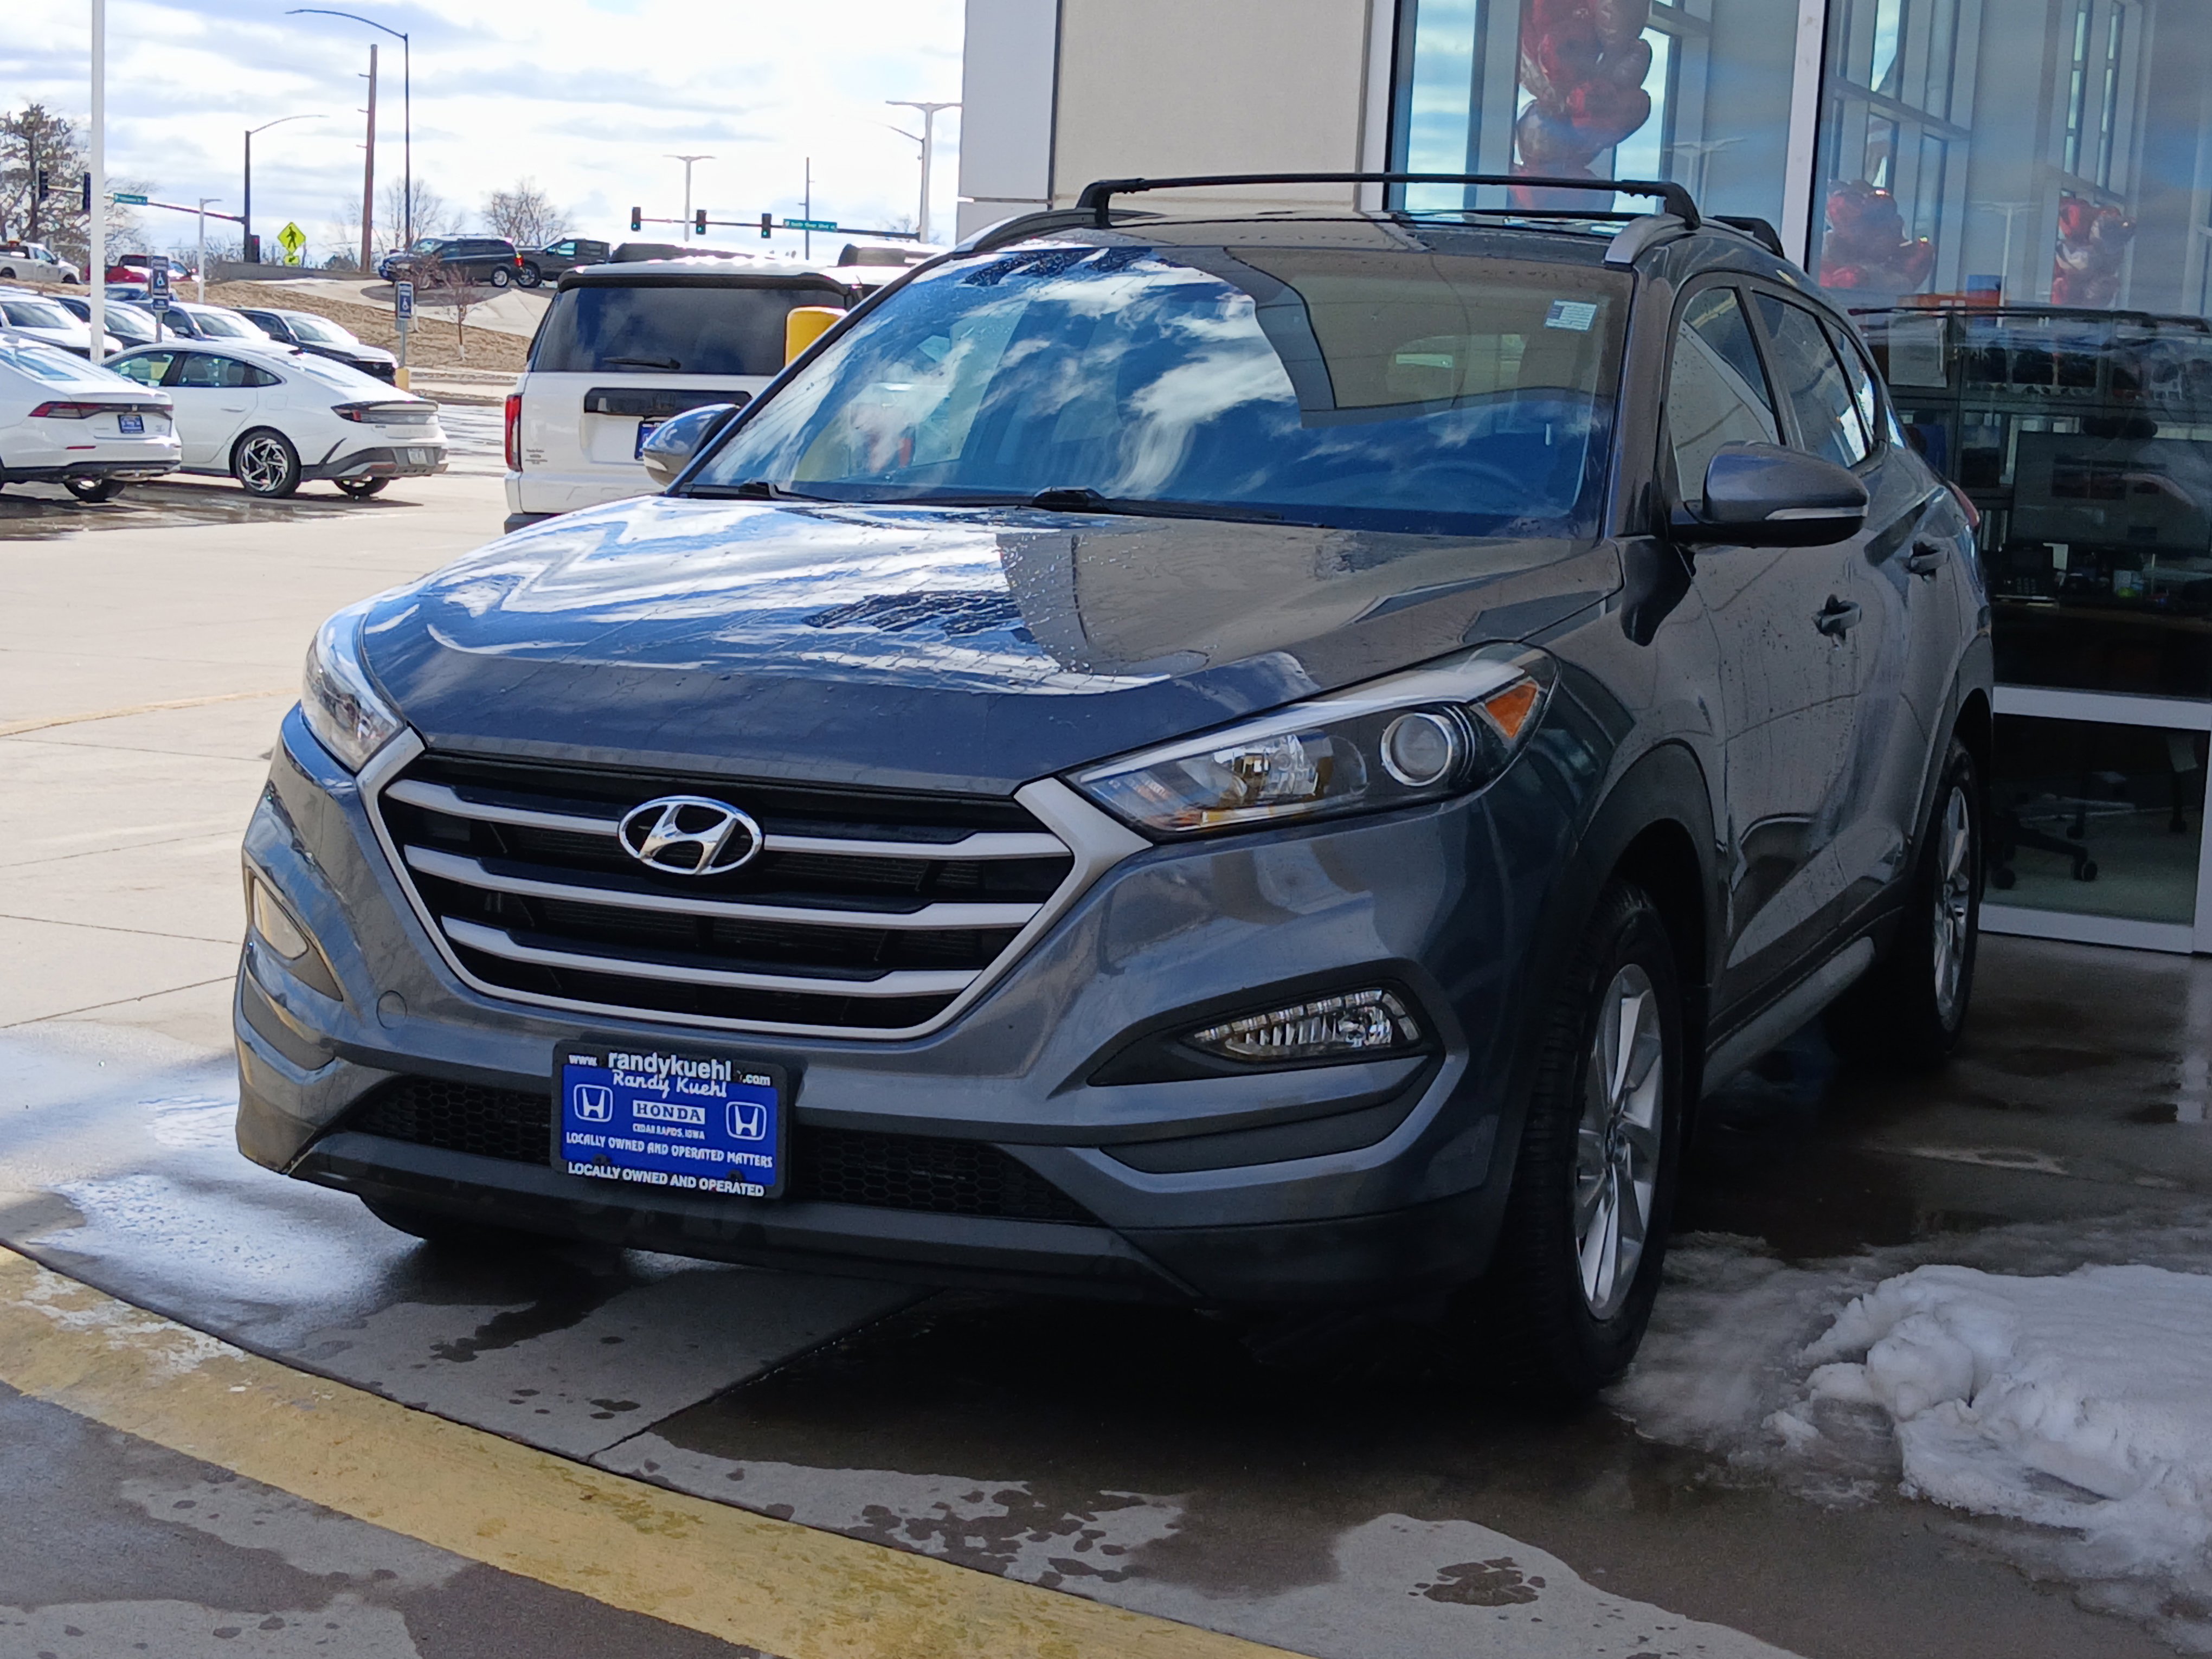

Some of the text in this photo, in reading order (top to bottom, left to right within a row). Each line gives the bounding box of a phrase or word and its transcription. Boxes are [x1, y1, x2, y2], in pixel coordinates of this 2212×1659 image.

[608, 1052, 731, 1082] randykuehl
[742, 1073, 771, 1086] .com
[612, 1069, 727, 1099] Randy Kuehl
[636, 1103, 702, 1122] HONDA
[566, 1131, 773, 1168] LOCALLY OWNED AND OPERATED MATTERS
[568, 1161, 764, 1197] LOCALLY OWNED AND OPERATED
